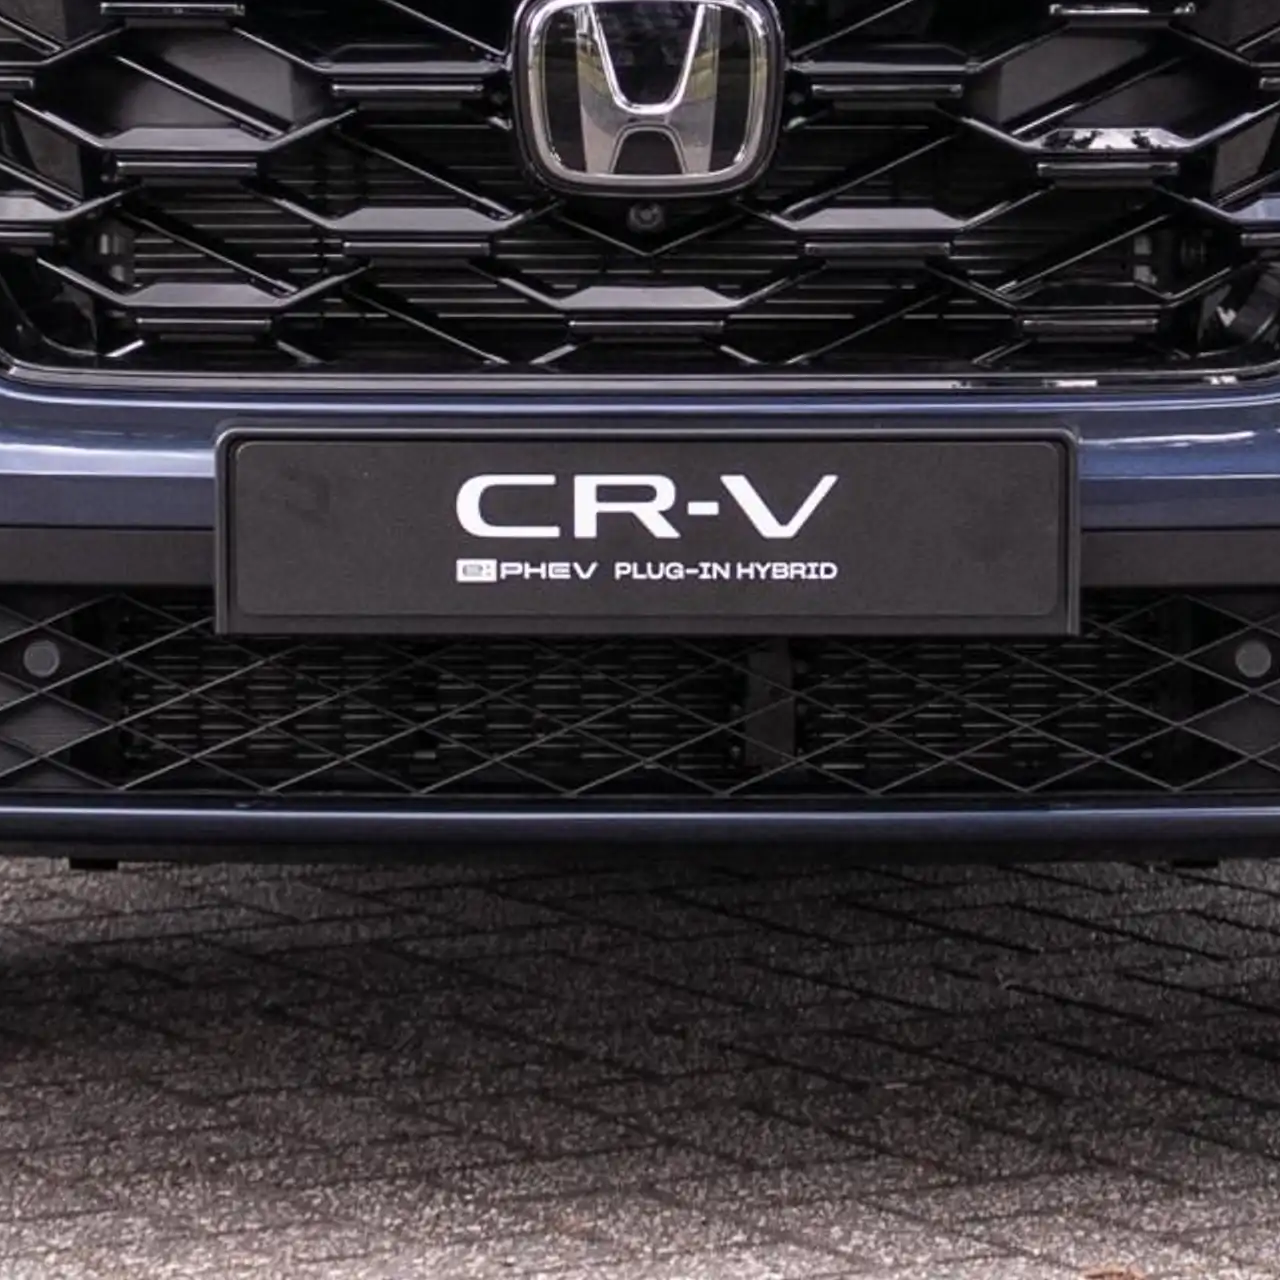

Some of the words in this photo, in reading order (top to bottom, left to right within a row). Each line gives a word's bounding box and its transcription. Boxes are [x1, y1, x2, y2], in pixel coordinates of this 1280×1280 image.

[455, 473, 839, 539] CR-V
[614, 561, 732, 581] PLUG-IN
[736, 561, 839, 581] HYBRID
